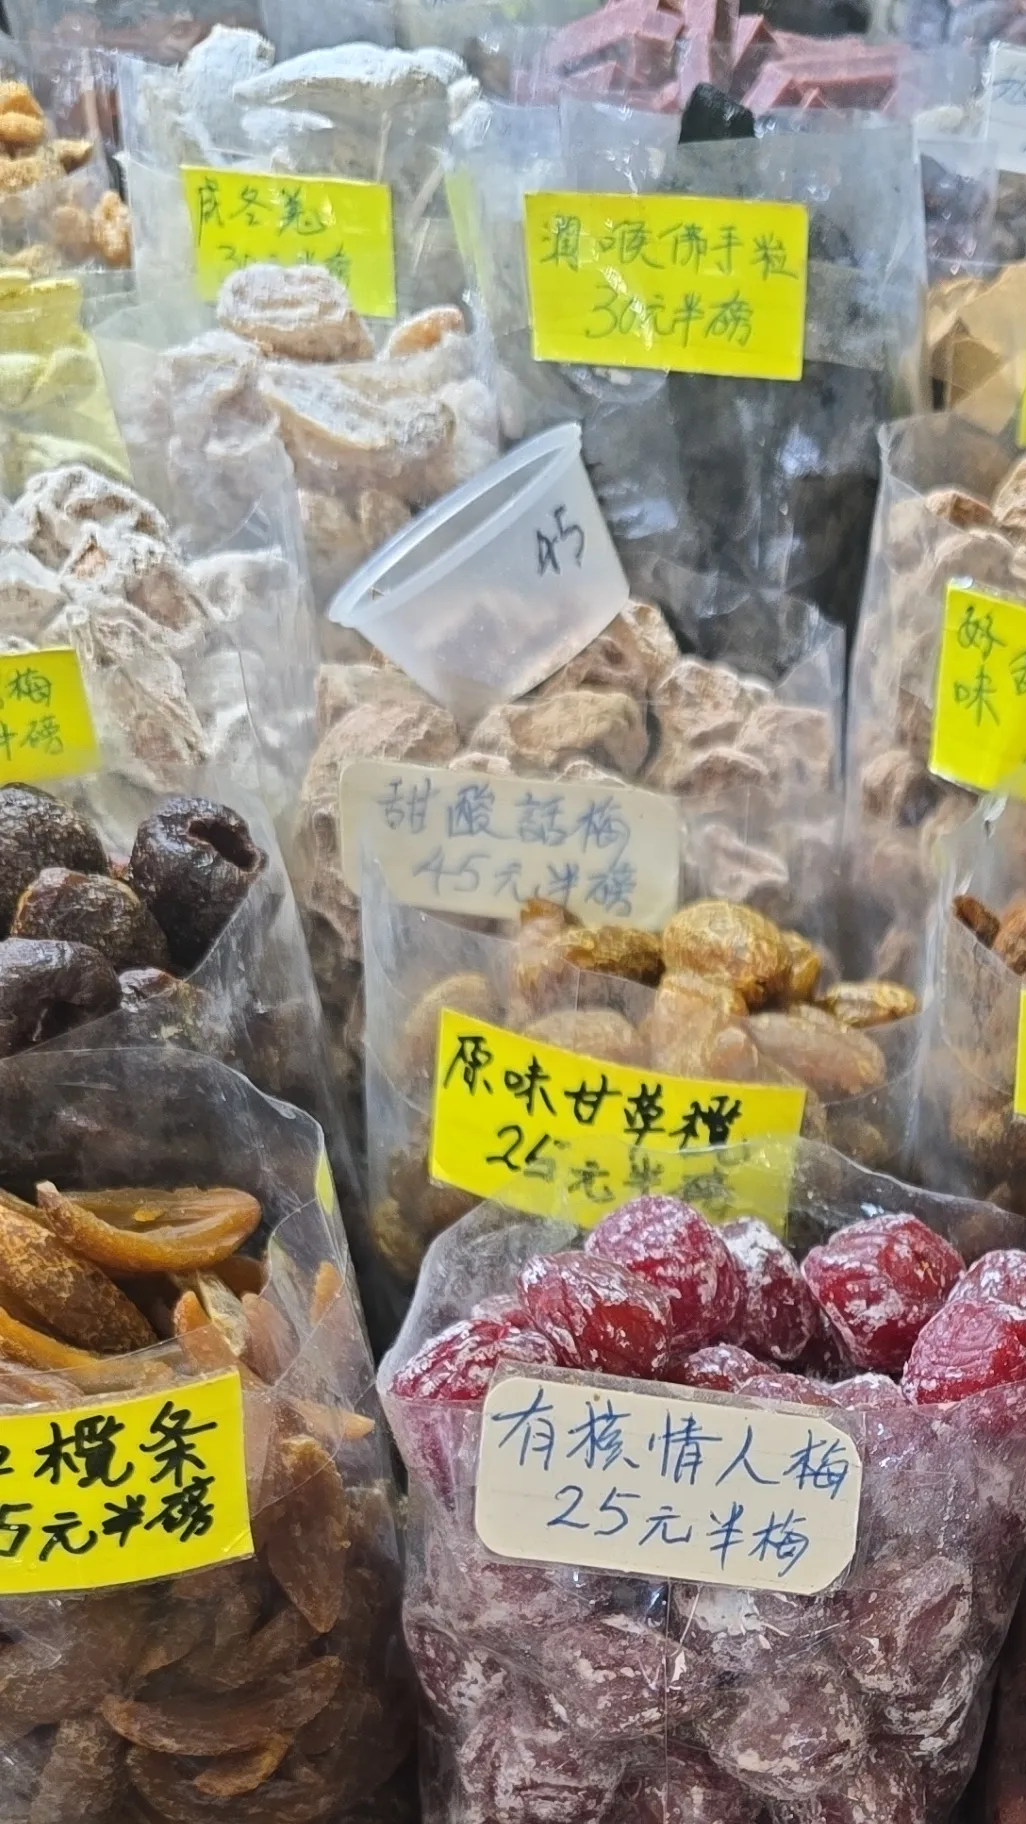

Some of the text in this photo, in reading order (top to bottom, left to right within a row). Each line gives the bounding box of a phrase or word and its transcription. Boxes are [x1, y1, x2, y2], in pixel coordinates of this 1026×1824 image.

[585, 282, 753, 348] 30元半磅
[952, 605, 1006, 727] 好味
[376, 777, 632, 856] 甜酸話梅
[412, 845, 637, 918] 45元半磅
[492, 1385, 854, 1500] 有核情人梅
[547, 1484, 810, 1578] 25元半梅
